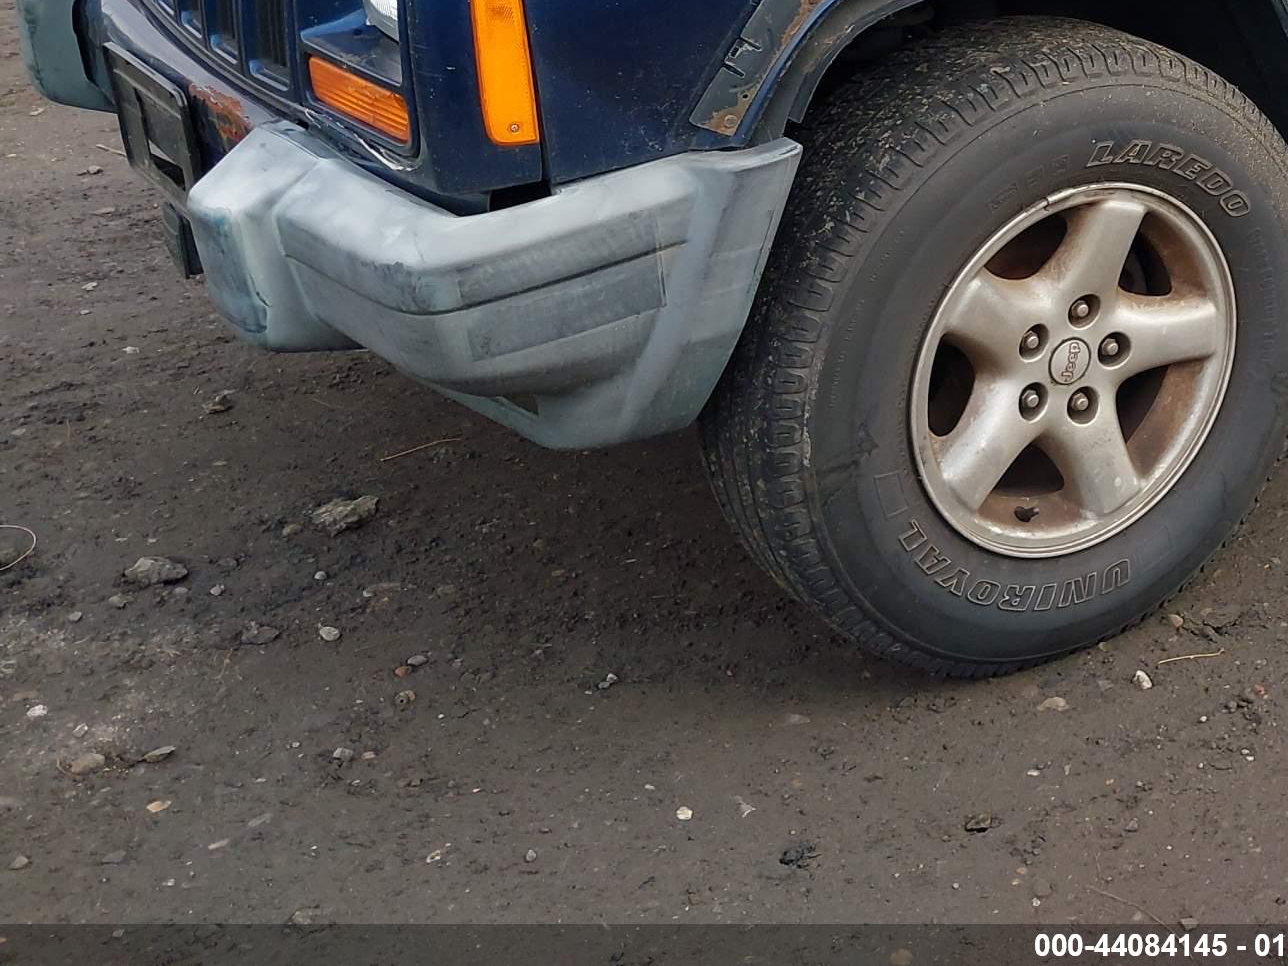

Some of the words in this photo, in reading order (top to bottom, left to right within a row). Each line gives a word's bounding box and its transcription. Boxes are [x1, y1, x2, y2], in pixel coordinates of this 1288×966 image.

[1085, 139, 1250, 217] LAREDO
[1061, 341, 1081, 382] Jeep
[899, 518, 1131, 611] UNIROYAL
